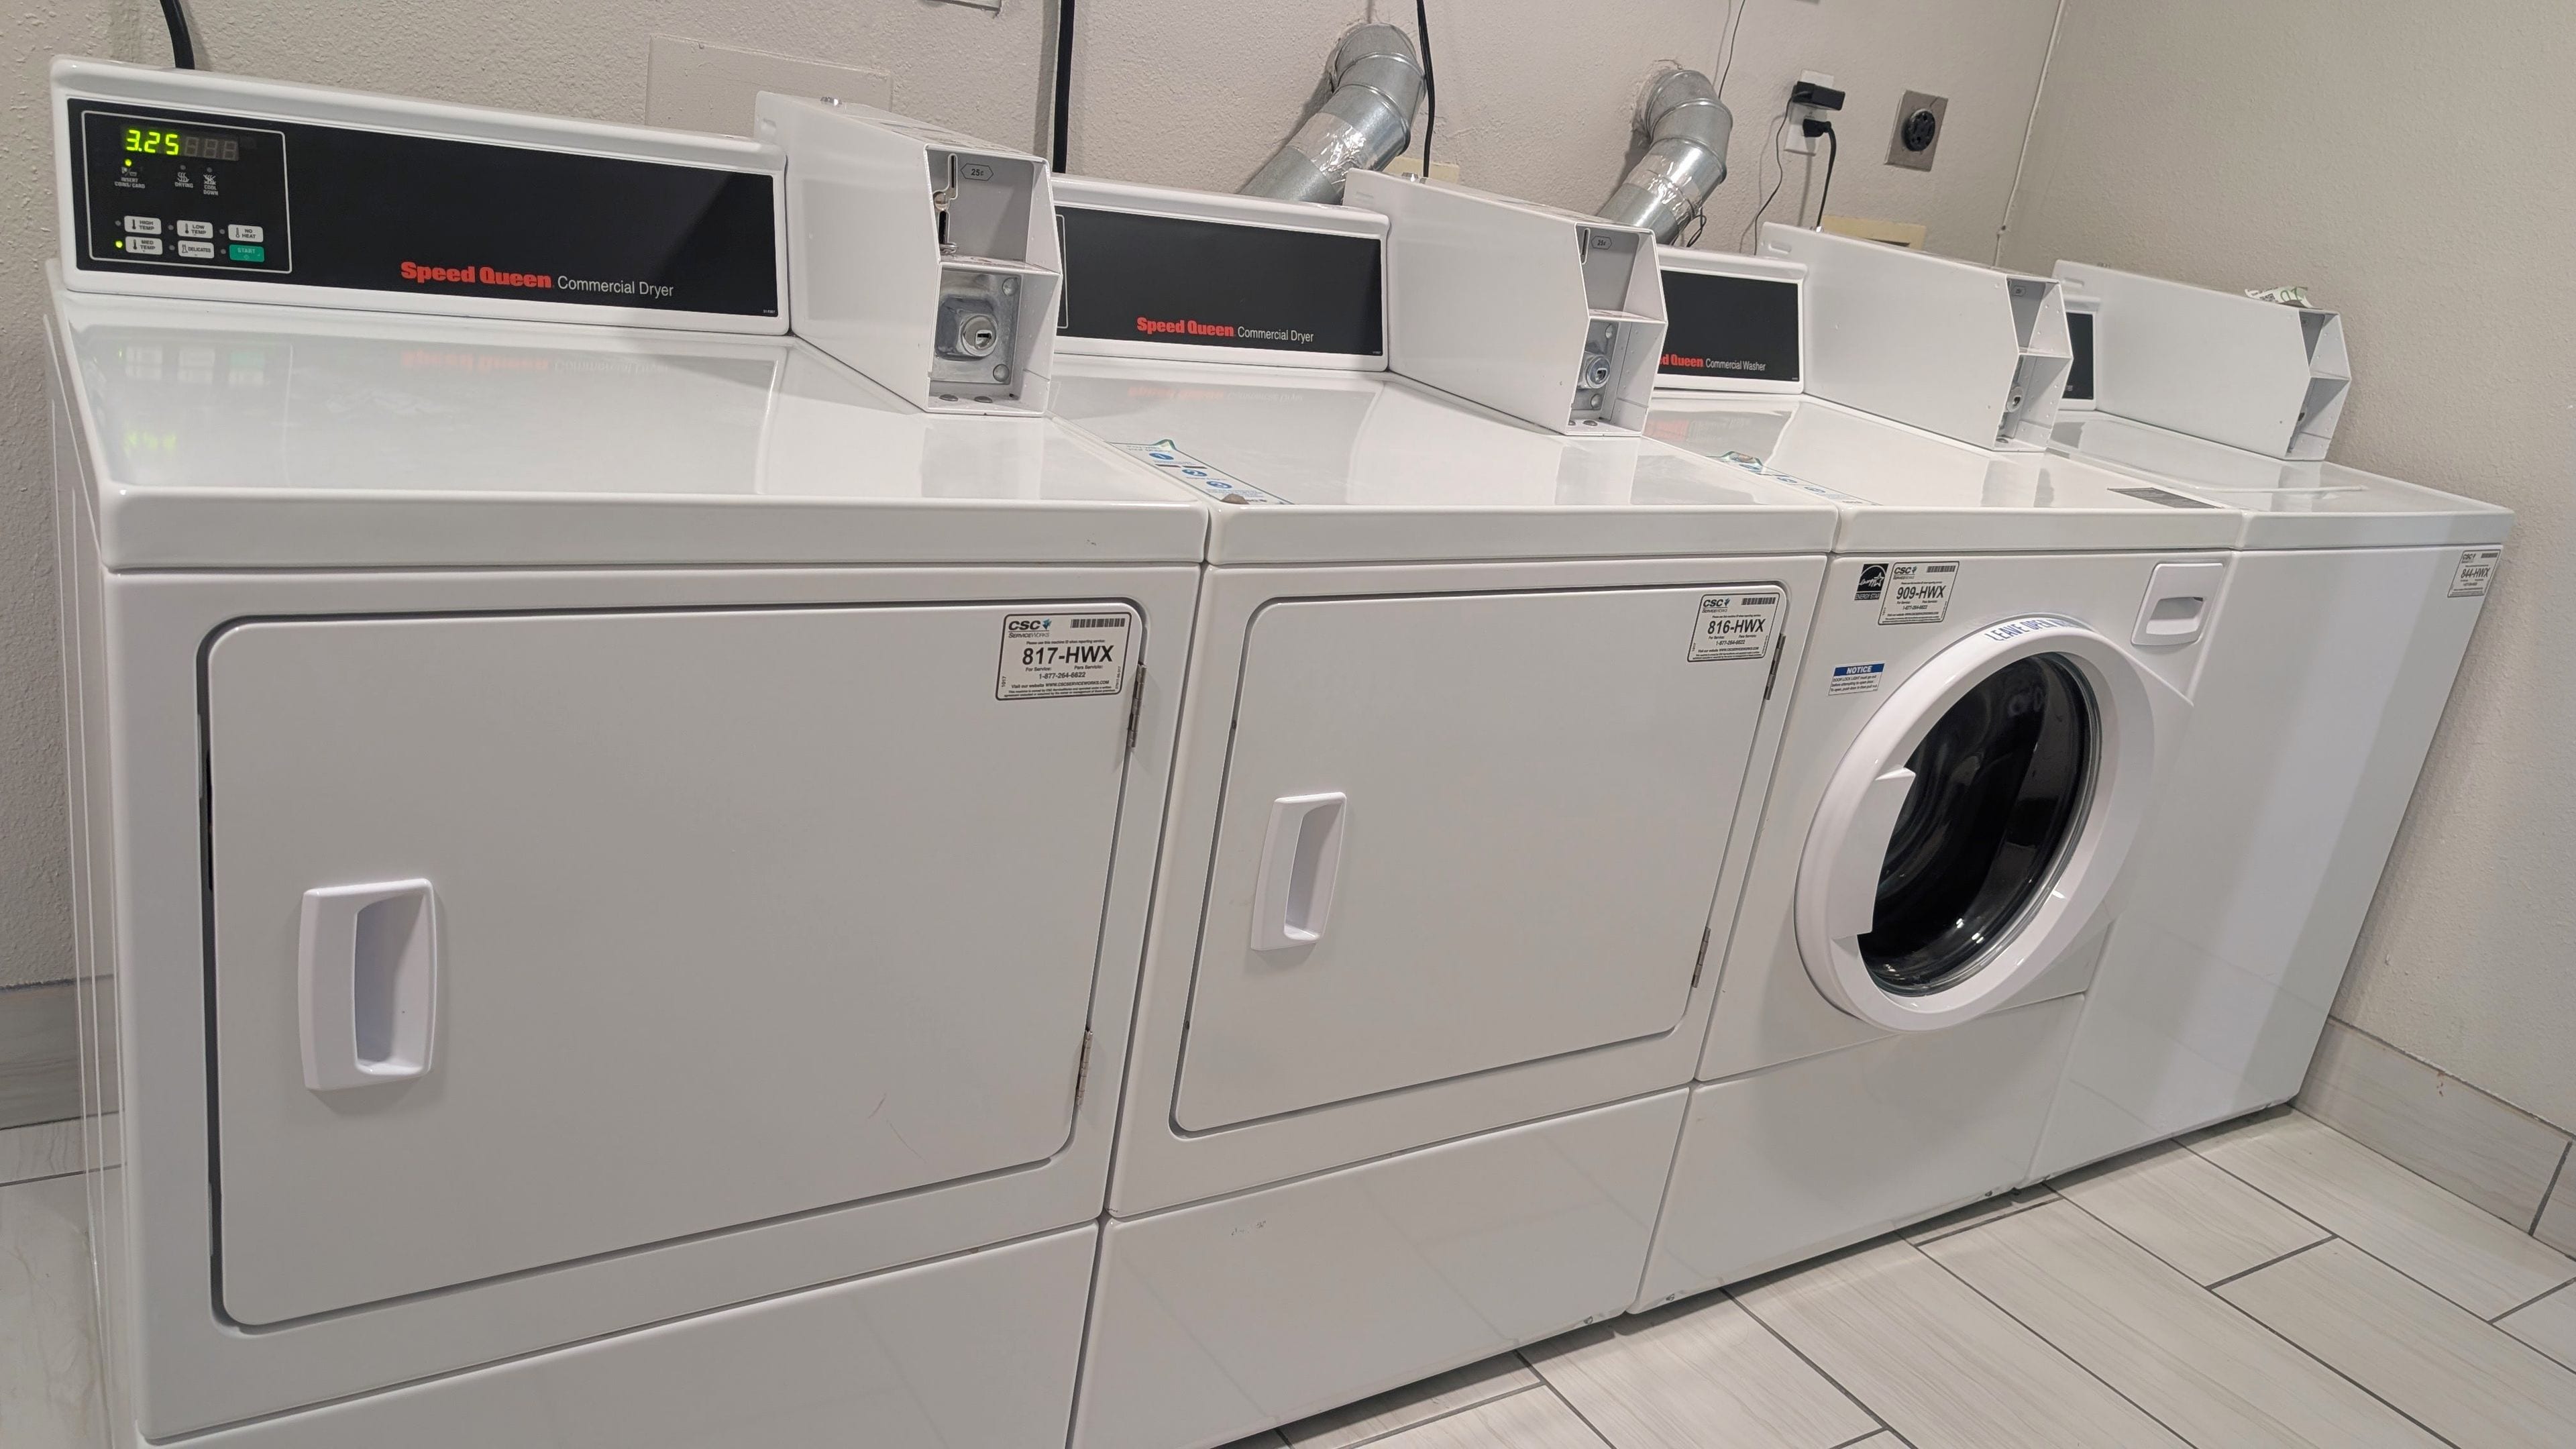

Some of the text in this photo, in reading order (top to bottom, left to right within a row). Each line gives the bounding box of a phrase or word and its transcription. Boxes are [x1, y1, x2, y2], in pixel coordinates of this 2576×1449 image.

[126, 129, 179, 156] 3.25
[400, 261, 674, 299] Speed Queen Commercial Dryer
[1136, 317, 1314, 344] Speed Queen Commercial Dryer
[1670, 354, 1704, 368] Queen
[1705, 358, 1741, 370] Commercial
[1743, 361, 1766, 371] Washer
[1894, 566, 1912, 574] CSC
[1896, 586, 1947, 600] 909-HWX
[1703, 599, 1724, 607] CSC
[1008, 620, 1040, 631] CSC
[1707, 619, 1766, 635] 816-HWX
[1984, 624, 2030, 641] LEAVE
[1022, 645, 1114, 665] 817-HWX
[1846, 665, 1873, 674] NOTICE
